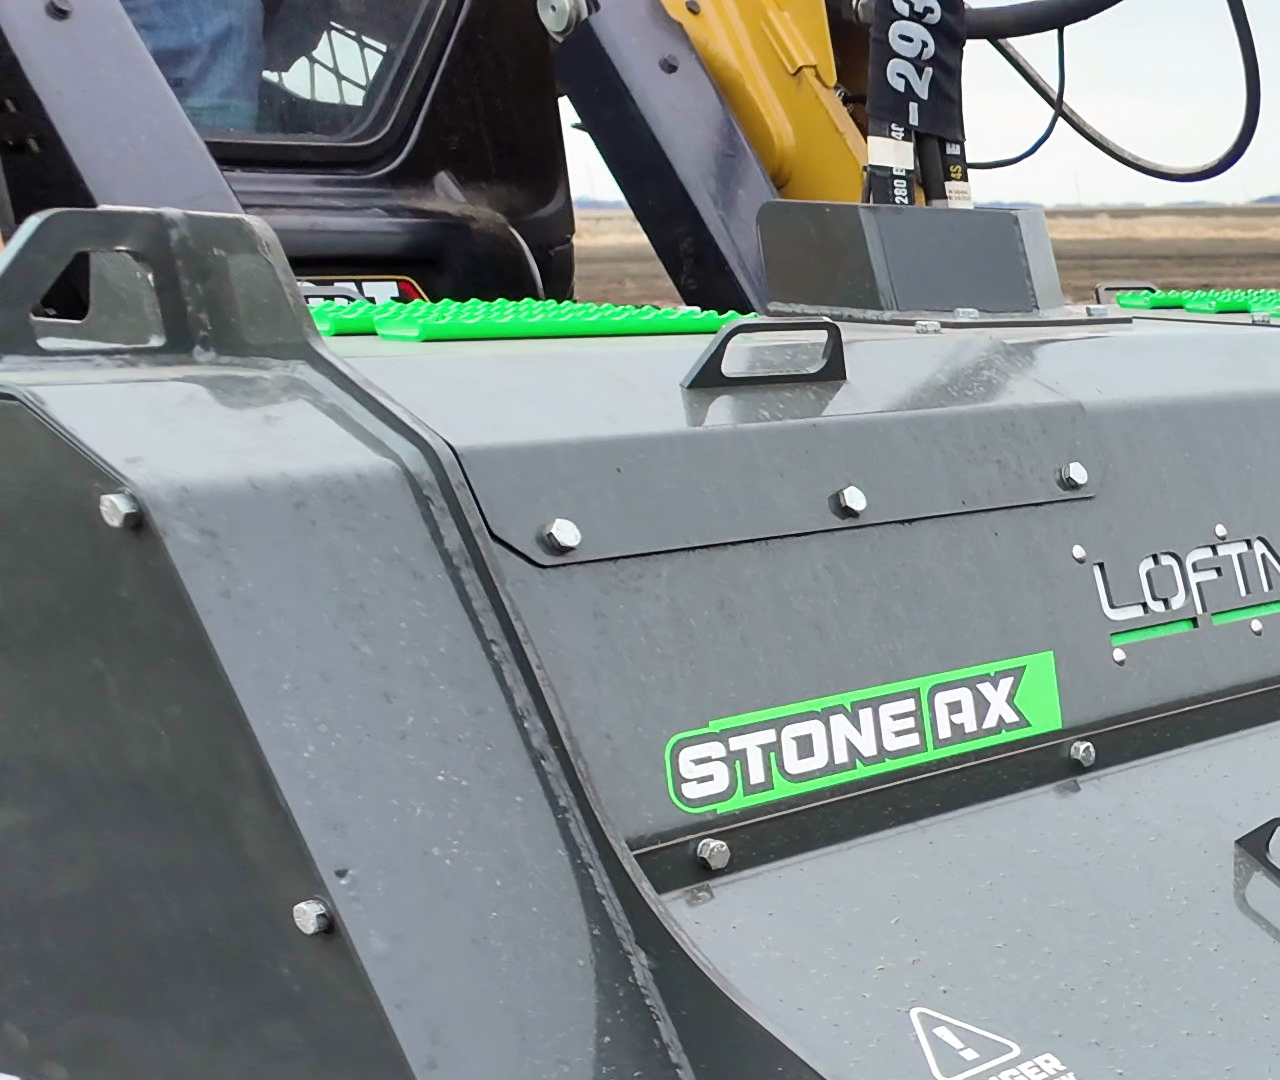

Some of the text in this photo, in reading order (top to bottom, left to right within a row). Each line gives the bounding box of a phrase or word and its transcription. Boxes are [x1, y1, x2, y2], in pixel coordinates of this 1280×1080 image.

[893, 179, 909, 205] 280
[678, 675, 1021, 800] STONE AX
